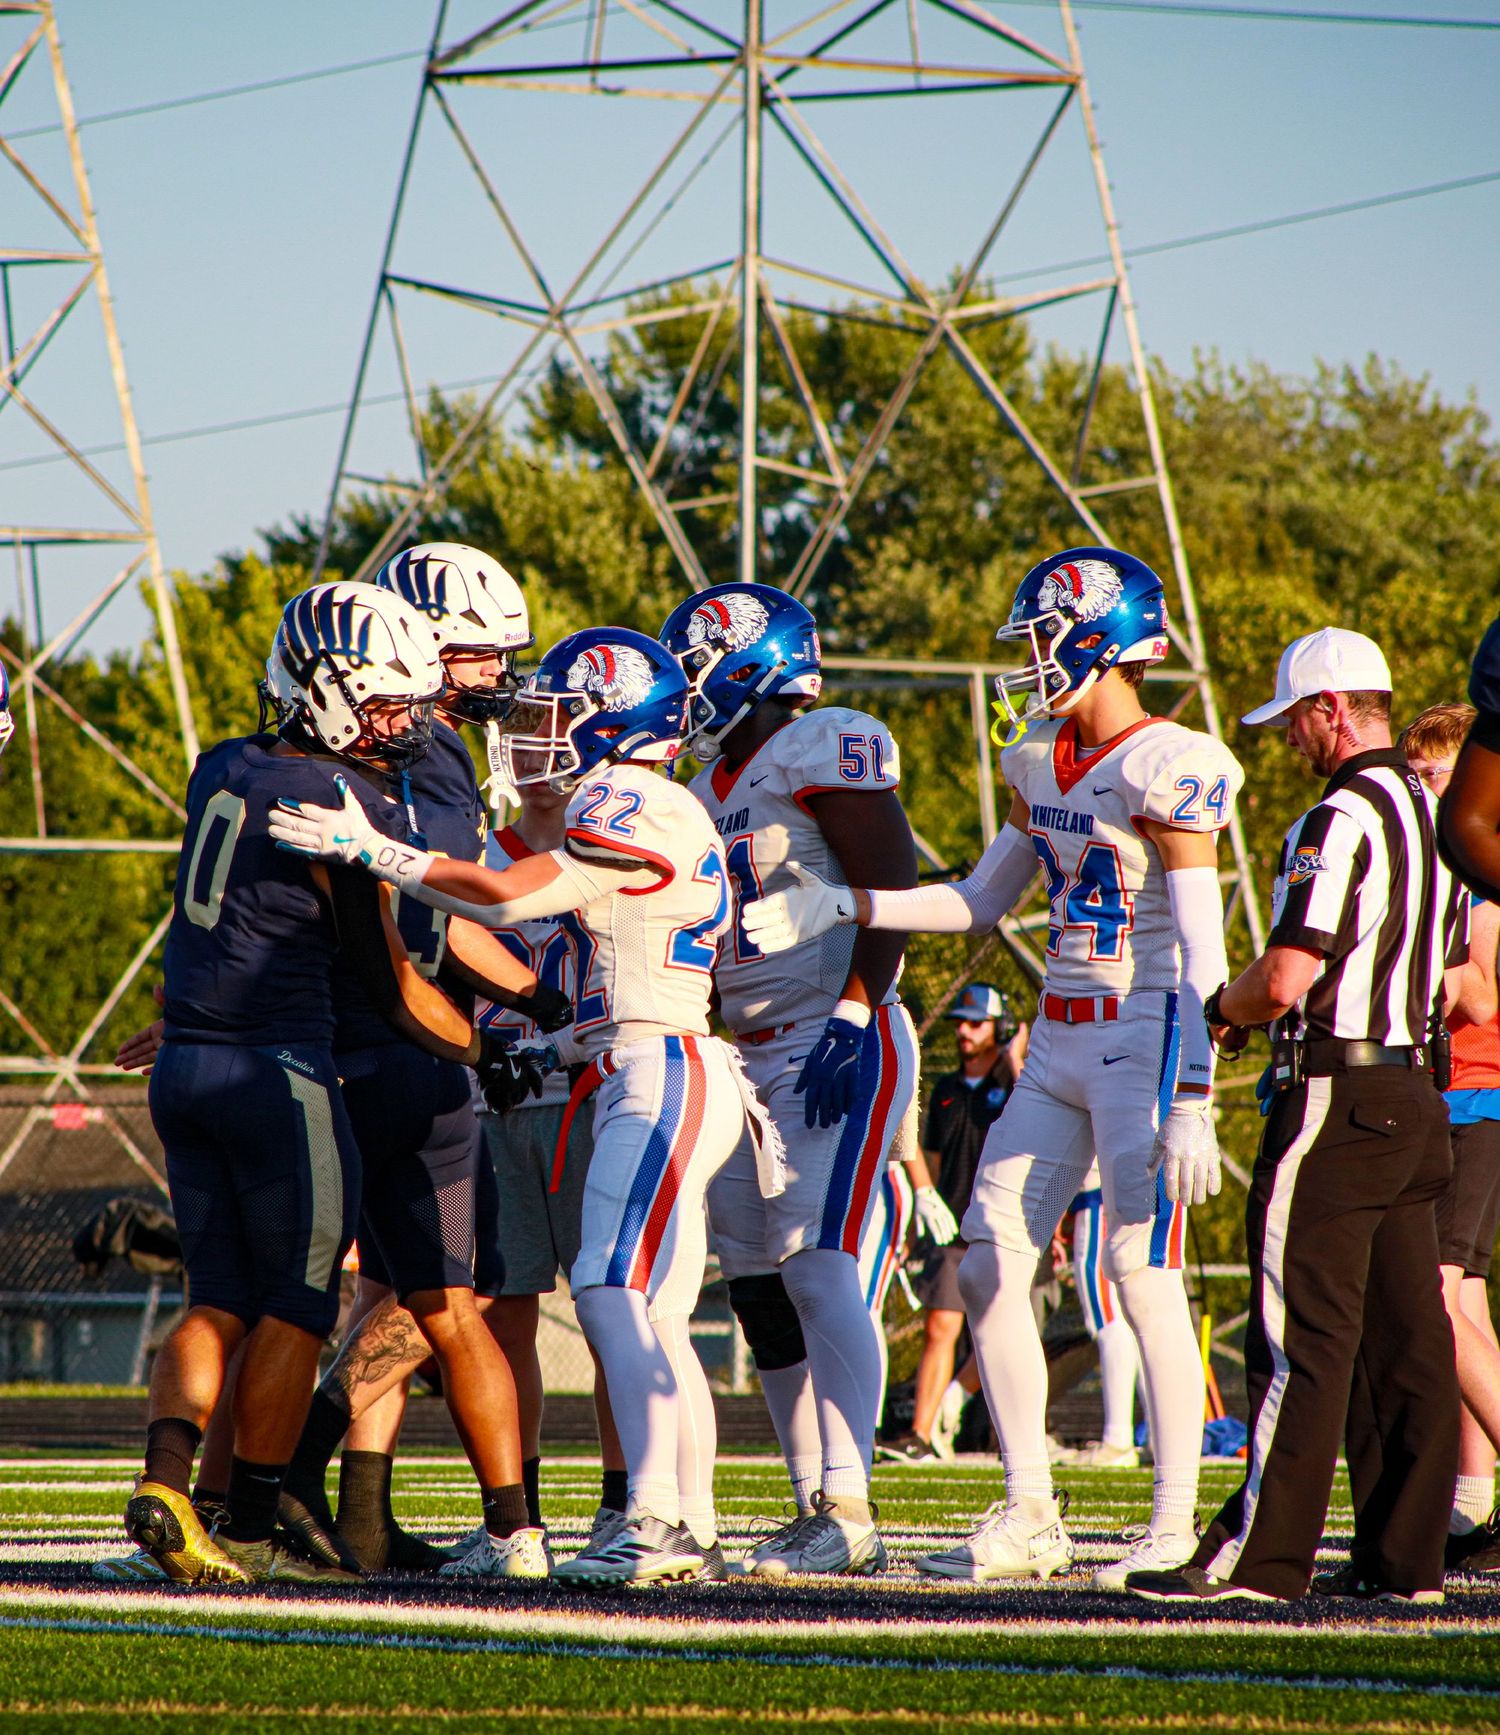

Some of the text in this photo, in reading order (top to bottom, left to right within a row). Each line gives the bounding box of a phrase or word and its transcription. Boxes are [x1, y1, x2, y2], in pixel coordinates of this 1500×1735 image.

[490, 745, 502, 772] NXTRND
[839, 734, 886, 782] 51
[576, 782, 645, 839] 22
[1031, 804, 1095, 836] WHITELAND
[1170, 775, 1229, 824] 24
[184, 789, 246, 931] 0
[1029, 829, 1135, 962] 24
[277, 1049, 316, 1074] Decatur
